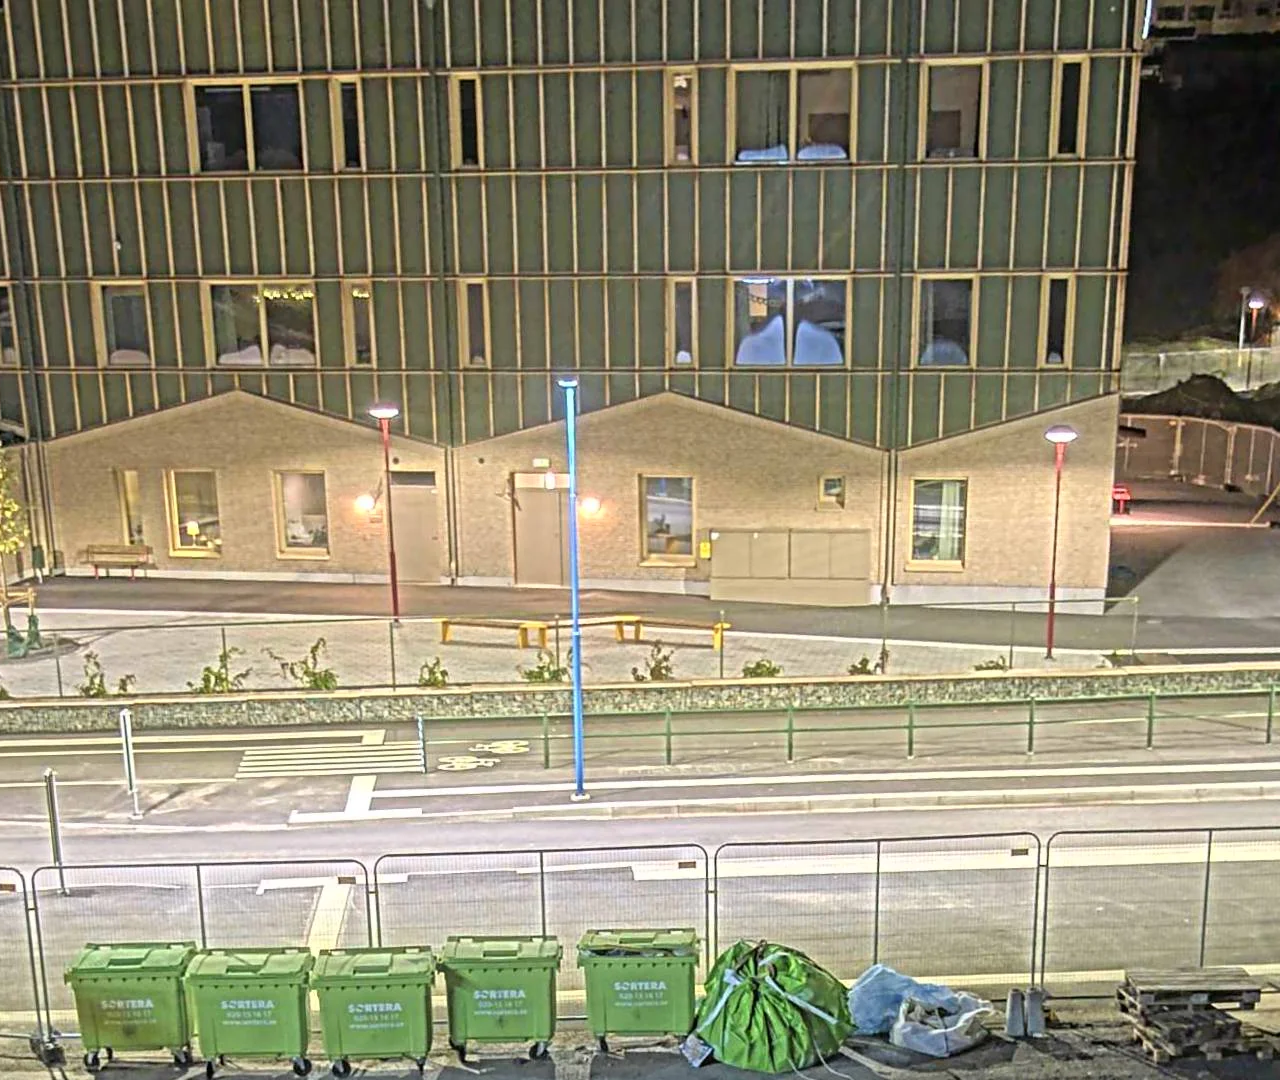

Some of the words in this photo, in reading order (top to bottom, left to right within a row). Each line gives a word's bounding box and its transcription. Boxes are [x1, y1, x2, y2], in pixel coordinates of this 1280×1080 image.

[613, 981, 667, 991] SORTERA
[473, 989, 526, 1000] SORTERA
[100, 998, 154, 1010] SORTERA
[220, 999, 275, 1010] SORTERA
[347, 1003, 402, 1014] SORTERA
